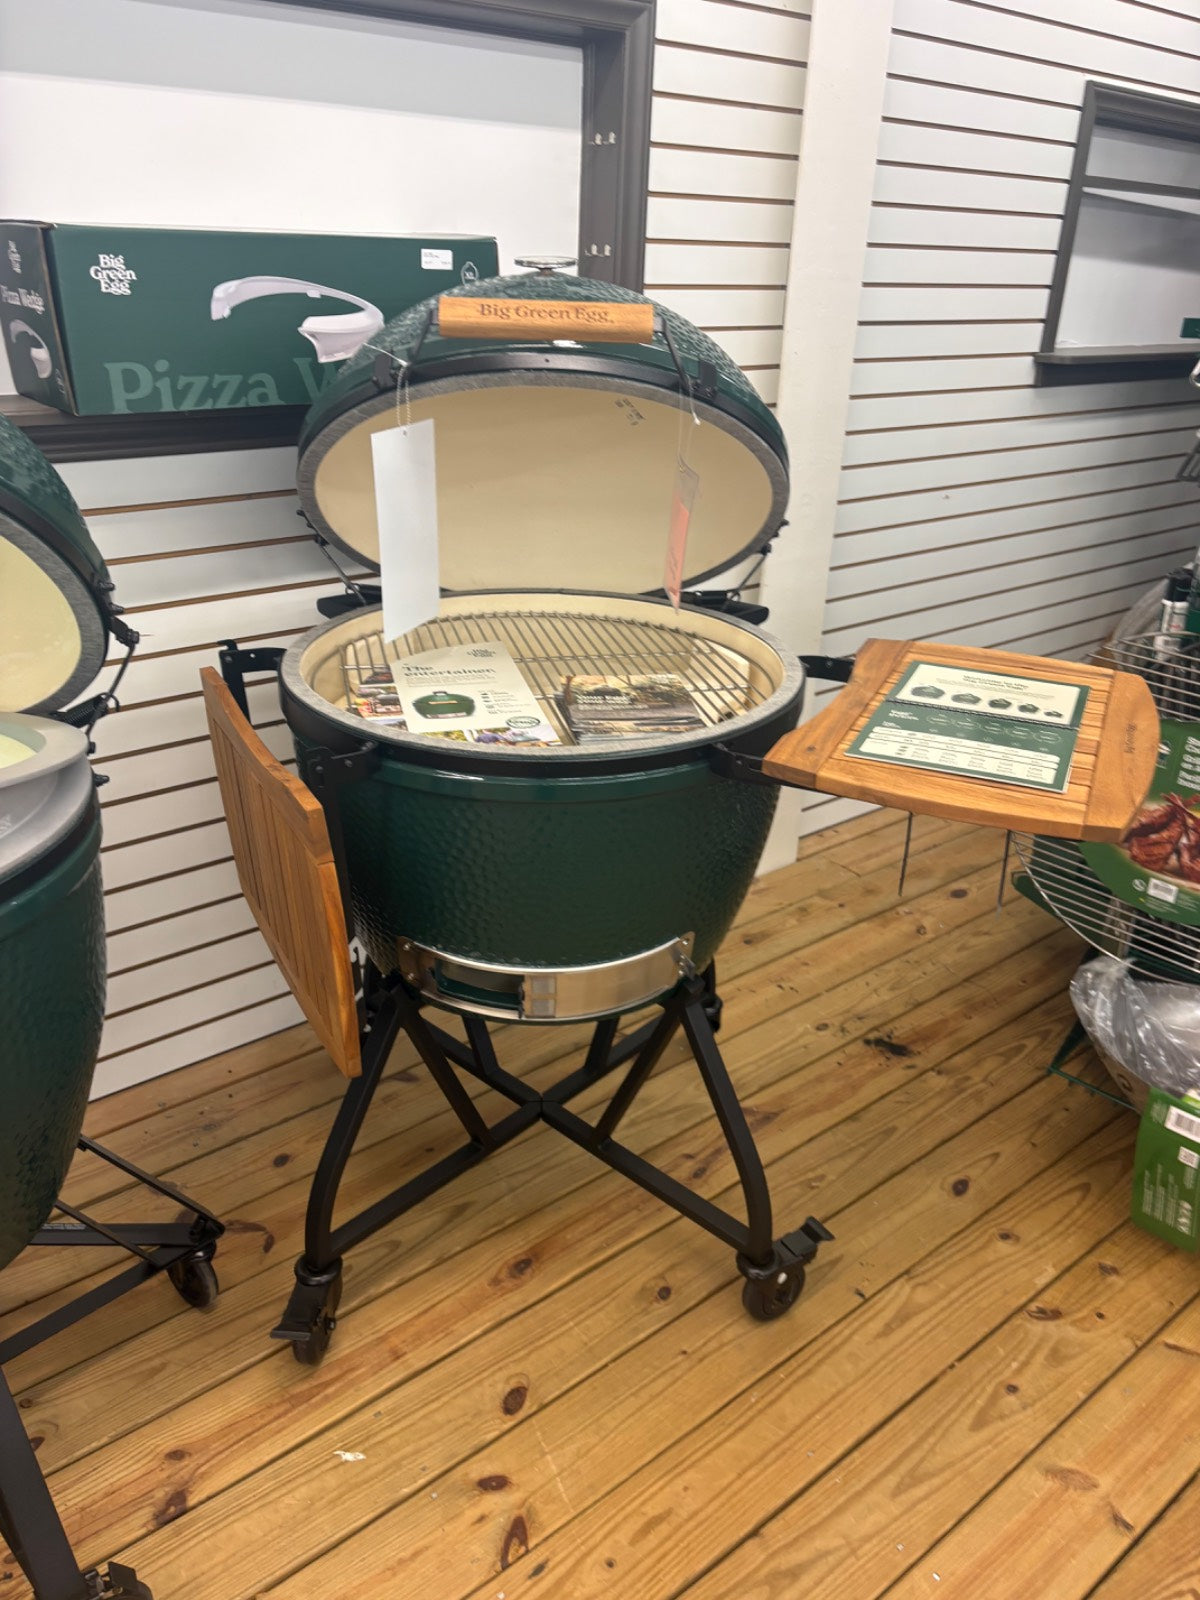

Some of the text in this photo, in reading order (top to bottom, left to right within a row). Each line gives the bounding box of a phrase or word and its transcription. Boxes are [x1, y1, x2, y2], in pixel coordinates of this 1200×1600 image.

[98, 253, 126, 271] Big
[89, 265, 137, 281] Green
[99, 279, 132, 296] Egg
[479, 303, 511, 320] Big
[514, 304, 573, 320] Green
[103, 358, 286, 416] Pizza
